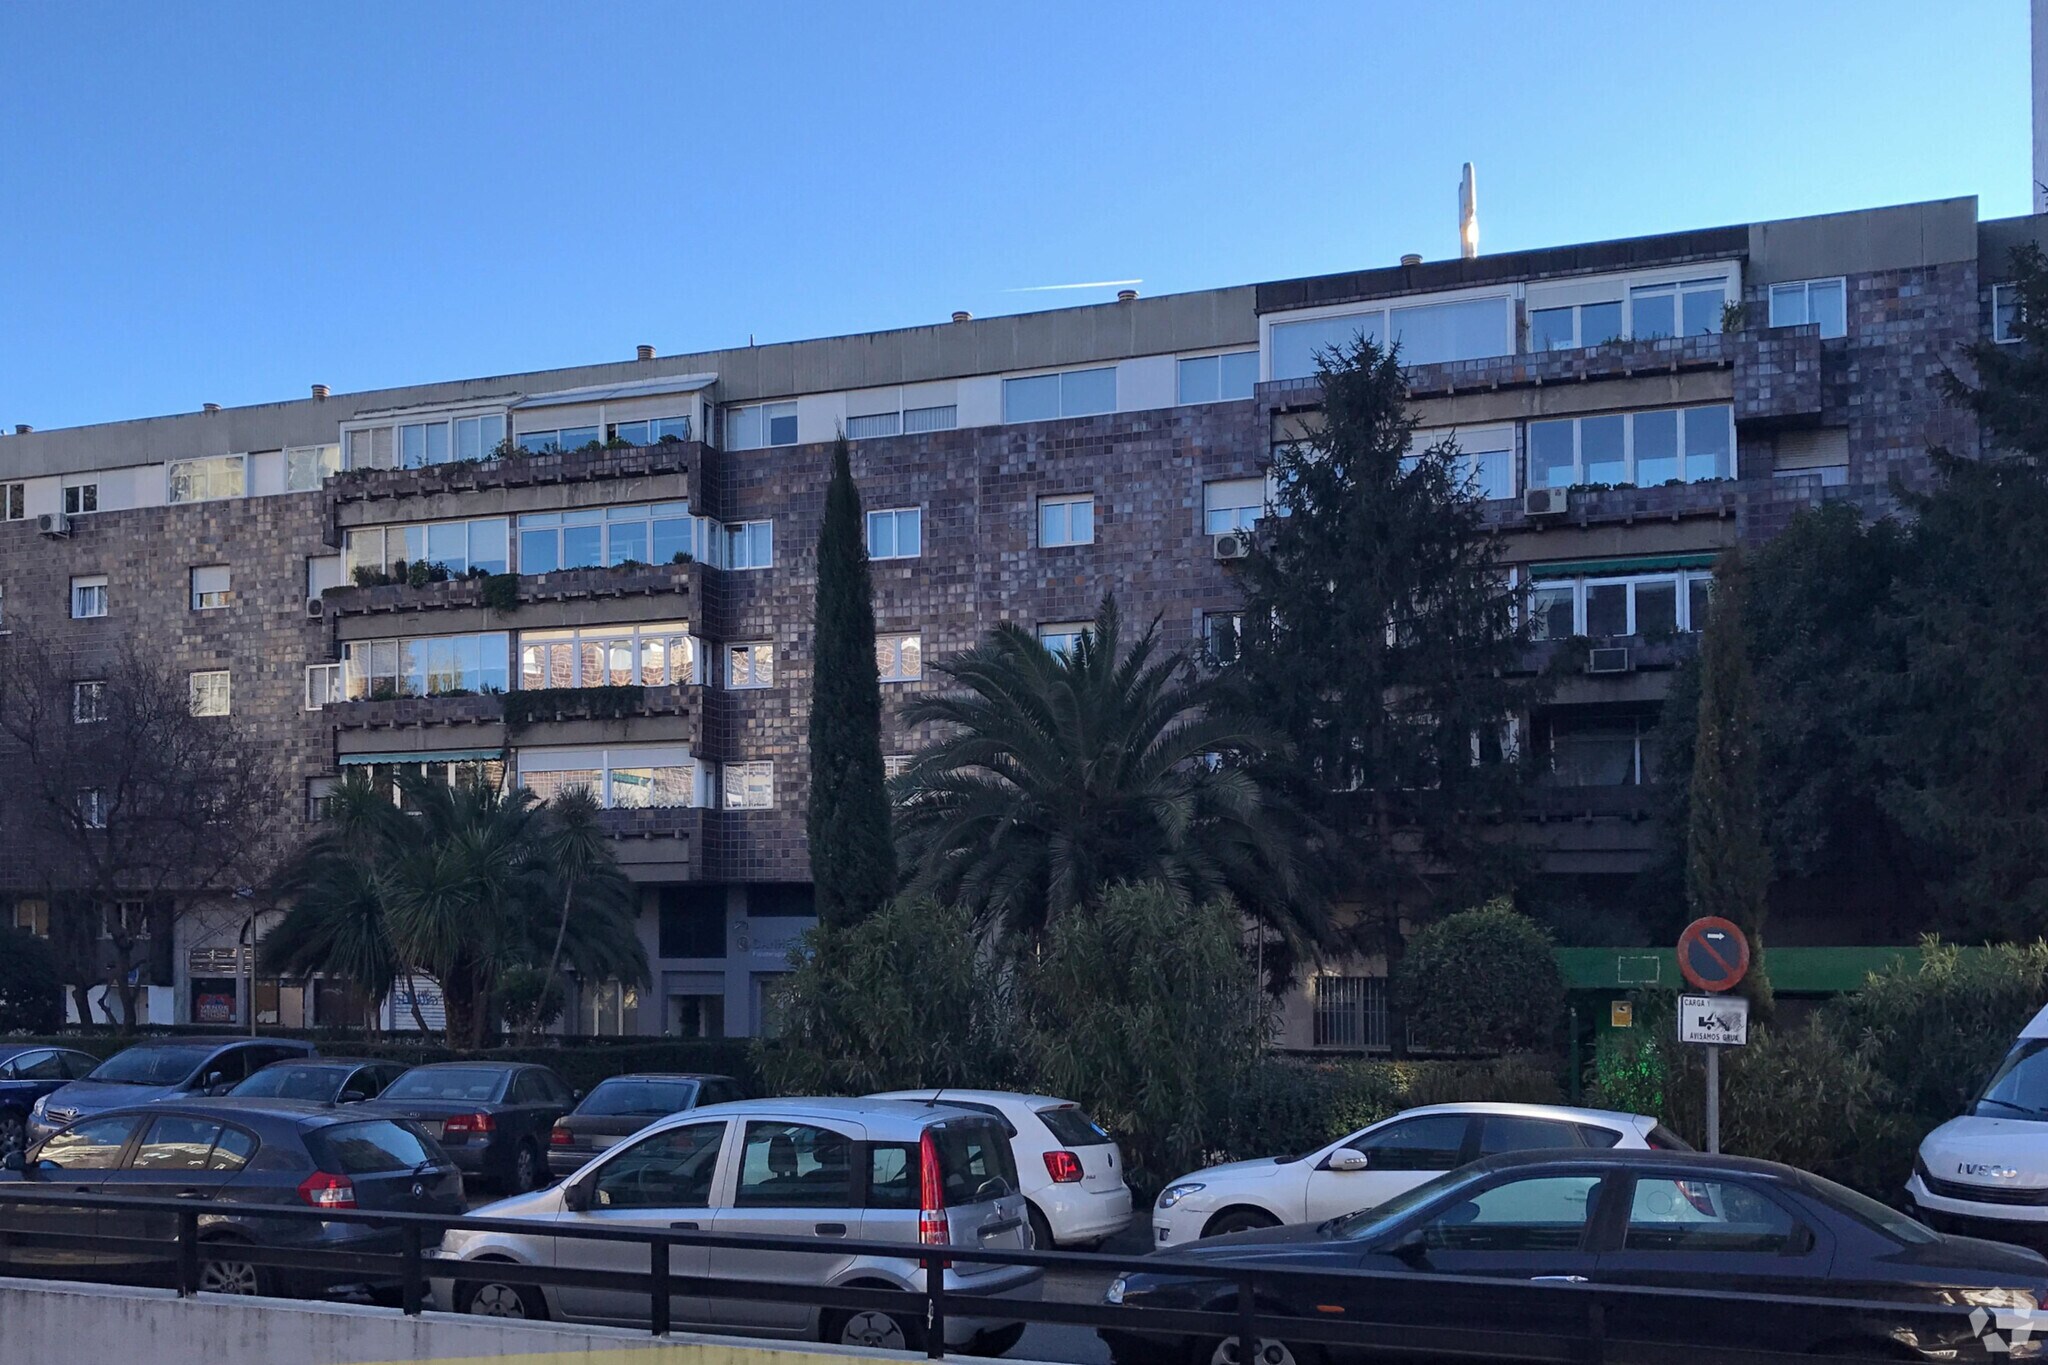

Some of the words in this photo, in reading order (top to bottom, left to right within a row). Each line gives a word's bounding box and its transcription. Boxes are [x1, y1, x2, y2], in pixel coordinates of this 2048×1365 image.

[1684, 998, 1705, 1007] CARGA
[1689, 1032, 1720, 1041] AVISAMOS
[1957, 1161, 2017, 1179] IVECO
